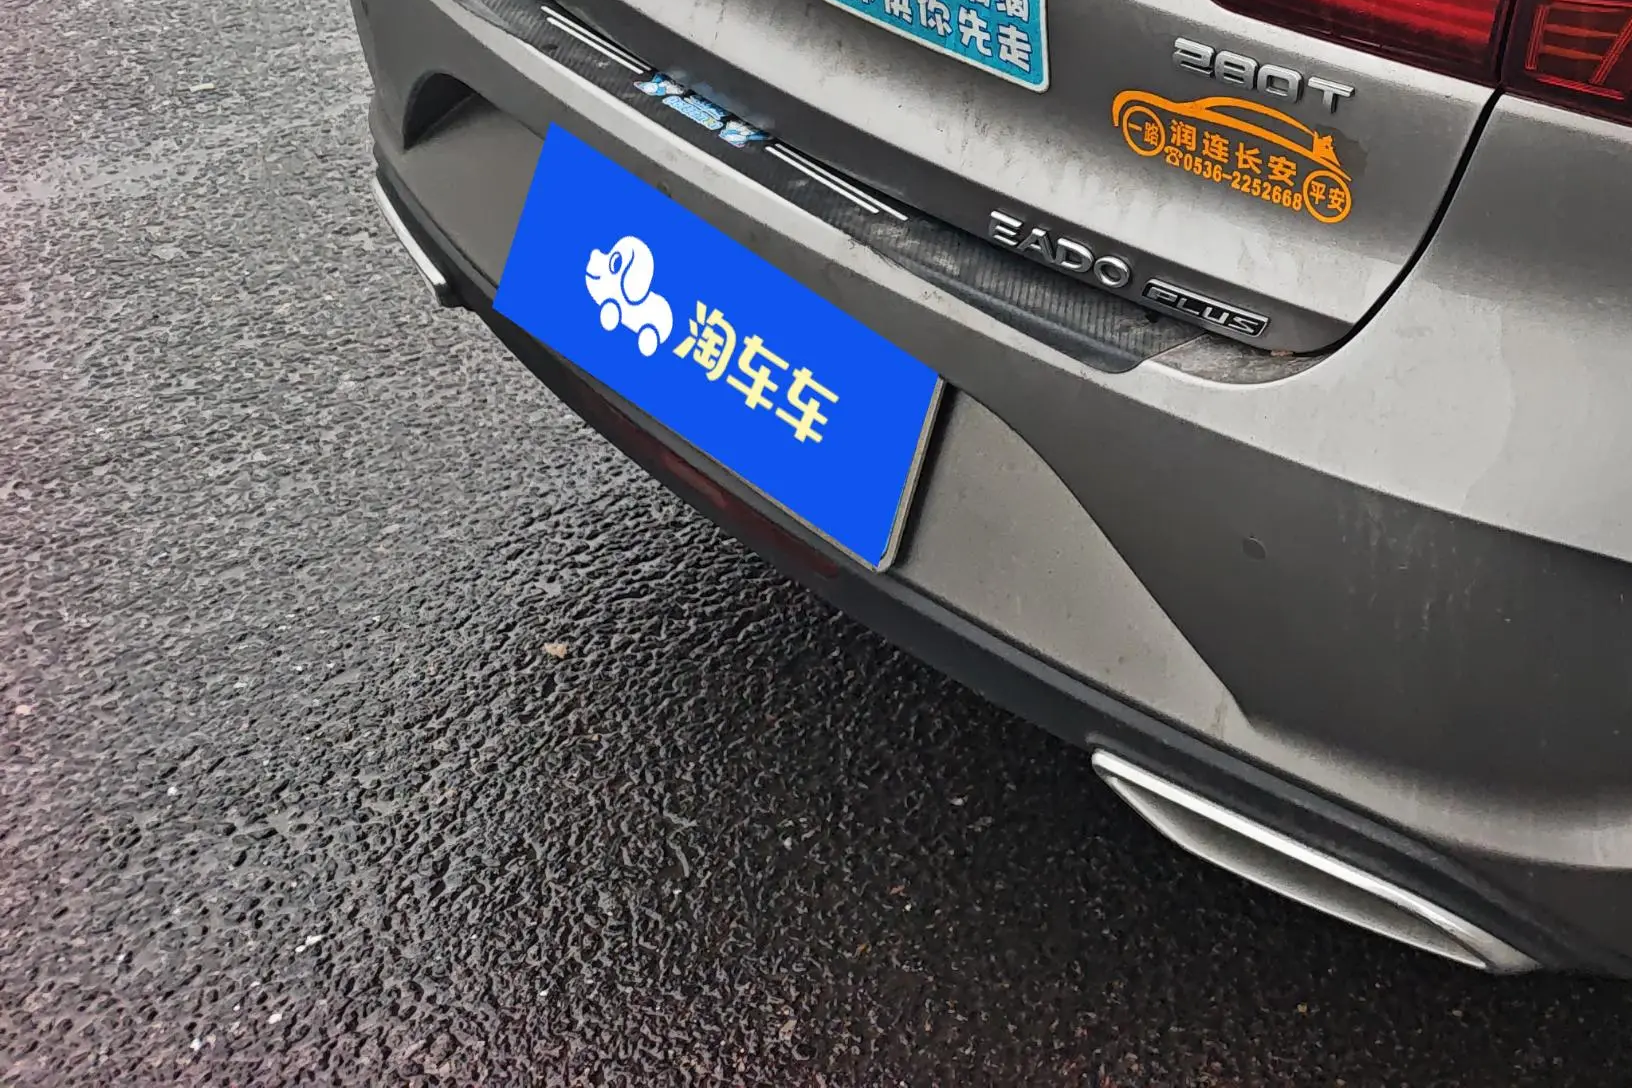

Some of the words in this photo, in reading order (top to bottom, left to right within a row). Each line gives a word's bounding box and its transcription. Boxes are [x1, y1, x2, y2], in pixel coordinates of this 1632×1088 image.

[1172, 37, 1355, 113] 280T
[1127, 120, 1159, 146] 一路
[1169, 119, 1297, 187] 润连长安
[1184, 156, 1302, 212] 0536-2252668
[1310, 180, 1346, 212] 平安
[988, 211, 1131, 288] EADO
[1147, 286, 1263, 335] PLUS
